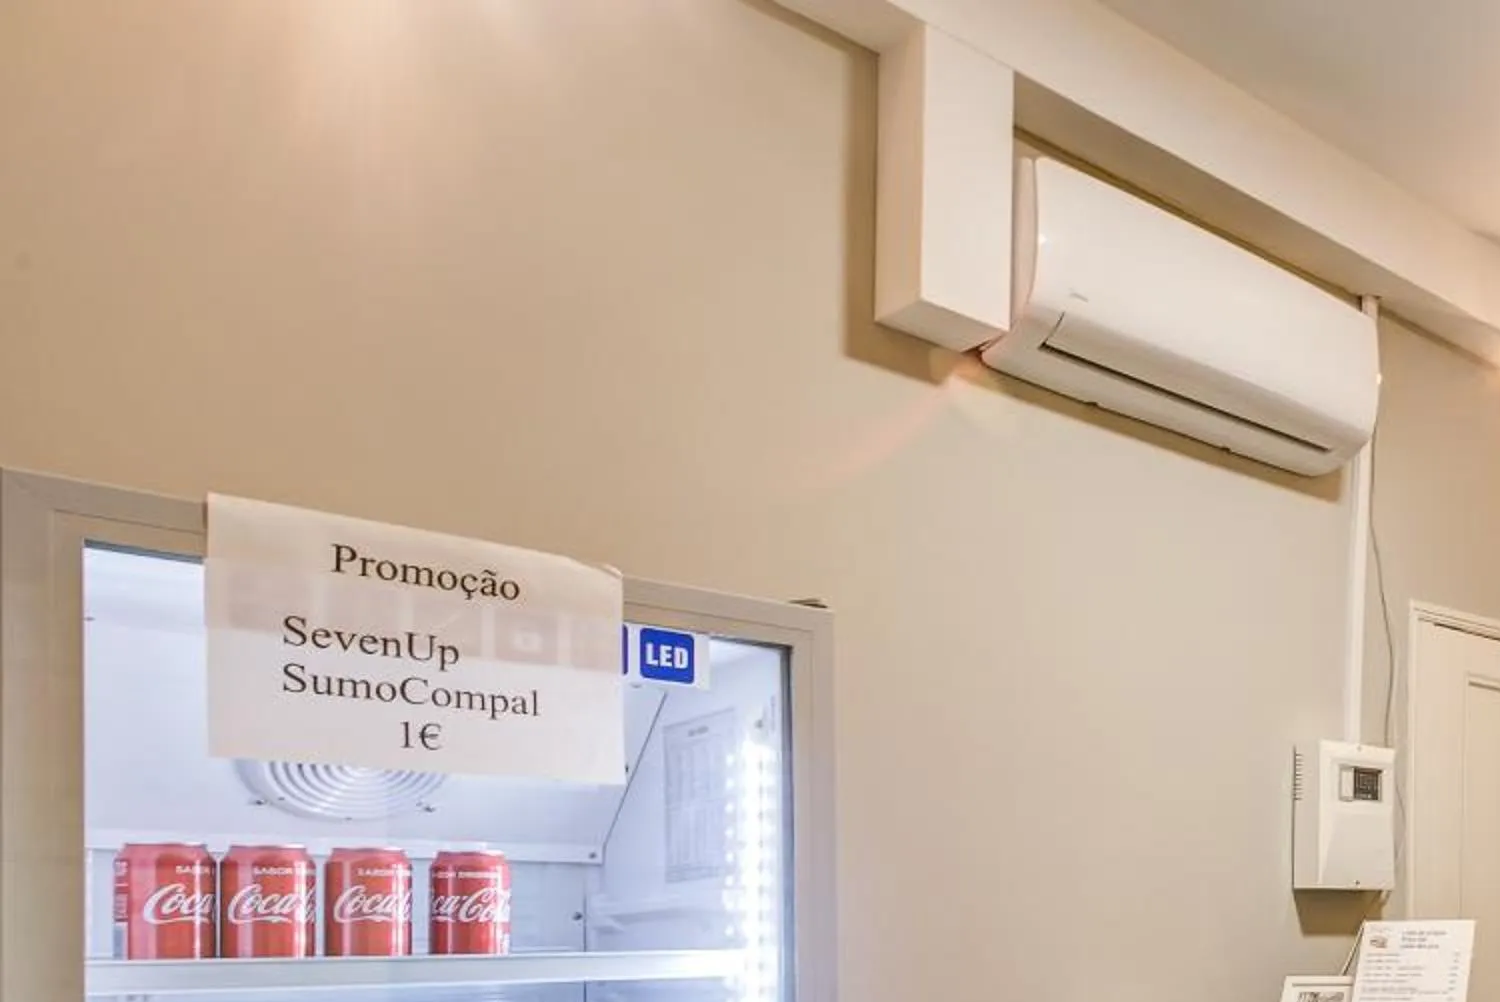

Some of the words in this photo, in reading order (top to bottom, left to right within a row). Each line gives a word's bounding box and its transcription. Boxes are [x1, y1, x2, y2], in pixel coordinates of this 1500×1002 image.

[331, 544, 521, 602] Promoção
[282, 615, 461, 672] SevenUp
[645, 641, 689, 670] LED
[282, 663, 540, 721] SumoCompal
[400, 722, 444, 751] 1€
